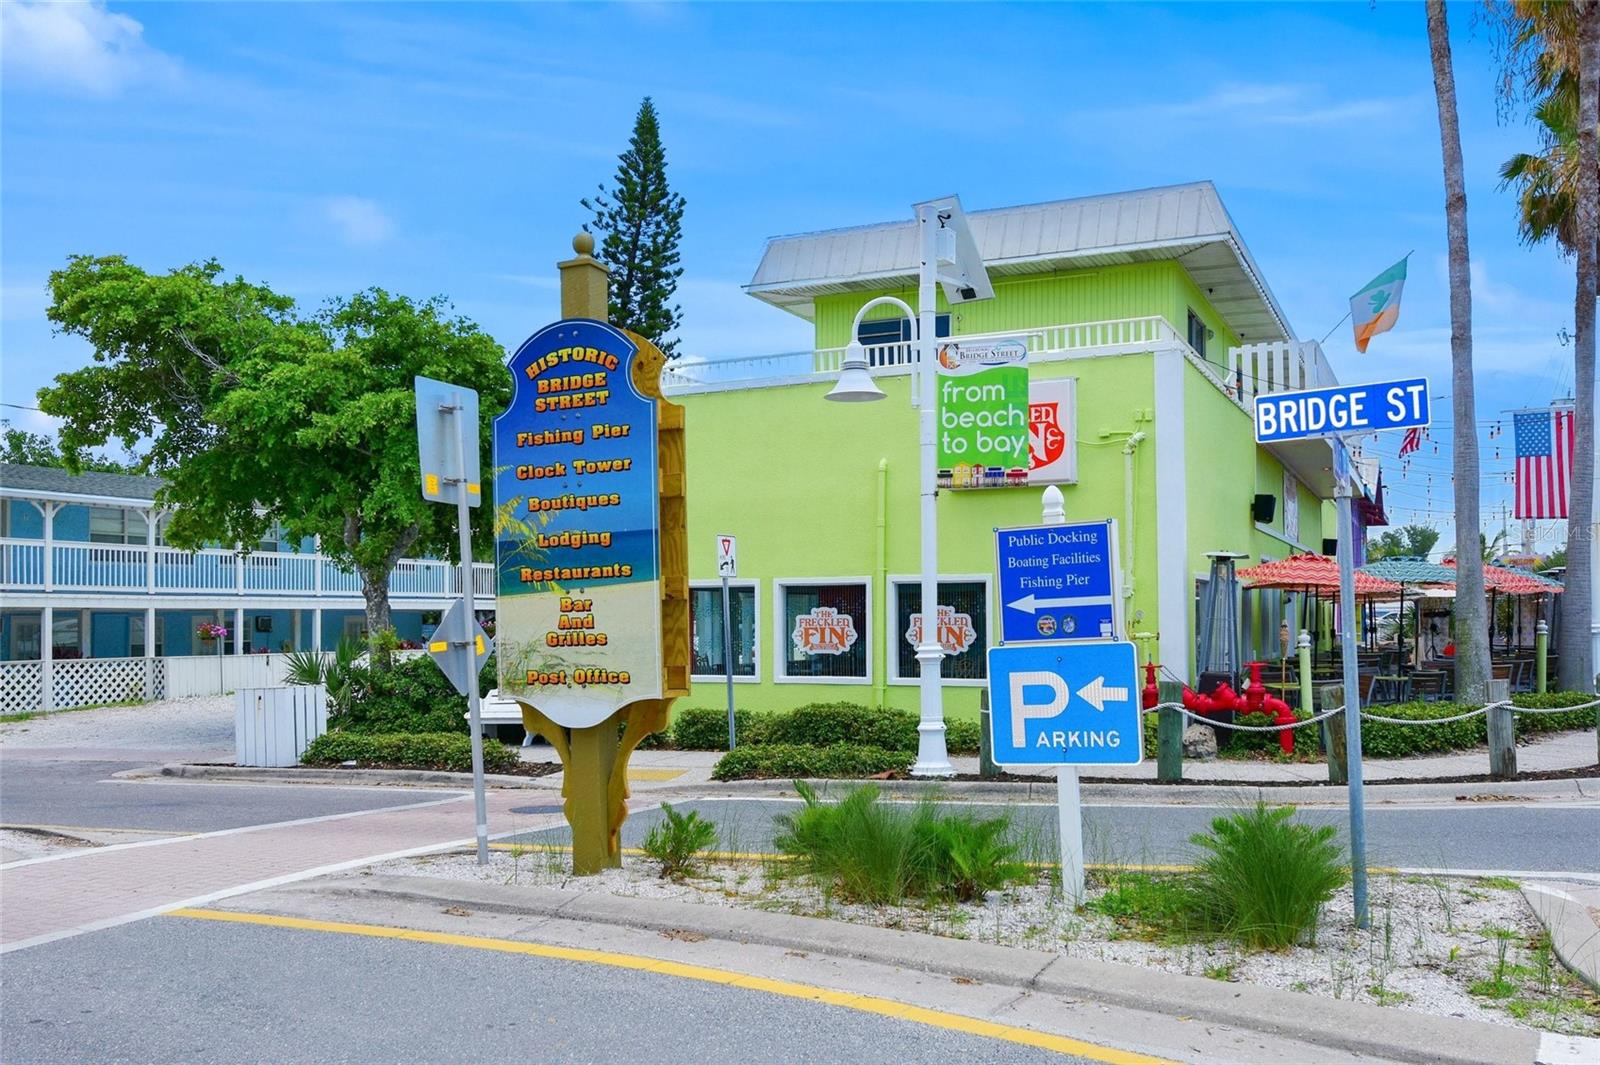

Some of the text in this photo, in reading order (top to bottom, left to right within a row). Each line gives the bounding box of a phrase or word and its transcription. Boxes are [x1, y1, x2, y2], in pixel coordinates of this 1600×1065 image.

[525, 346, 619, 380] HISTORIC
[991, 350, 1018, 358] STREET
[537, 372, 607, 394] BRIDGE
[534, 390, 609, 412] STREET
[942, 381, 1006, 404] from
[942, 403, 1025, 429] beach
[1258, 385, 1425, 436] BRIDGE ST
[516, 423, 631, 447] Fishing Pier
[942, 431, 967, 454] to
[976, 430, 1025, 458] bay
[516, 458, 632, 480] Clock Tower
[528, 493, 620, 512] Boutiques
[537, 531, 612, 548] Lodging
[1008, 531, 1098, 547] Public Docking
[1008, 552, 1101, 569] Boating Facilities
[520, 562, 632, 582] Restaurants
[1020, 574, 1090, 589] Fishing Pier
[560, 597, 592, 613] Bar
[815, 610, 832, 618] THE
[937, 609, 951, 617] HE
[558, 614, 594, 630] And
[799, 618, 850, 628] FRECKLED
[546, 631, 608, 647] Grilles
[803, 626, 847, 648] FIN
[526, 669, 631, 685] Post Office
